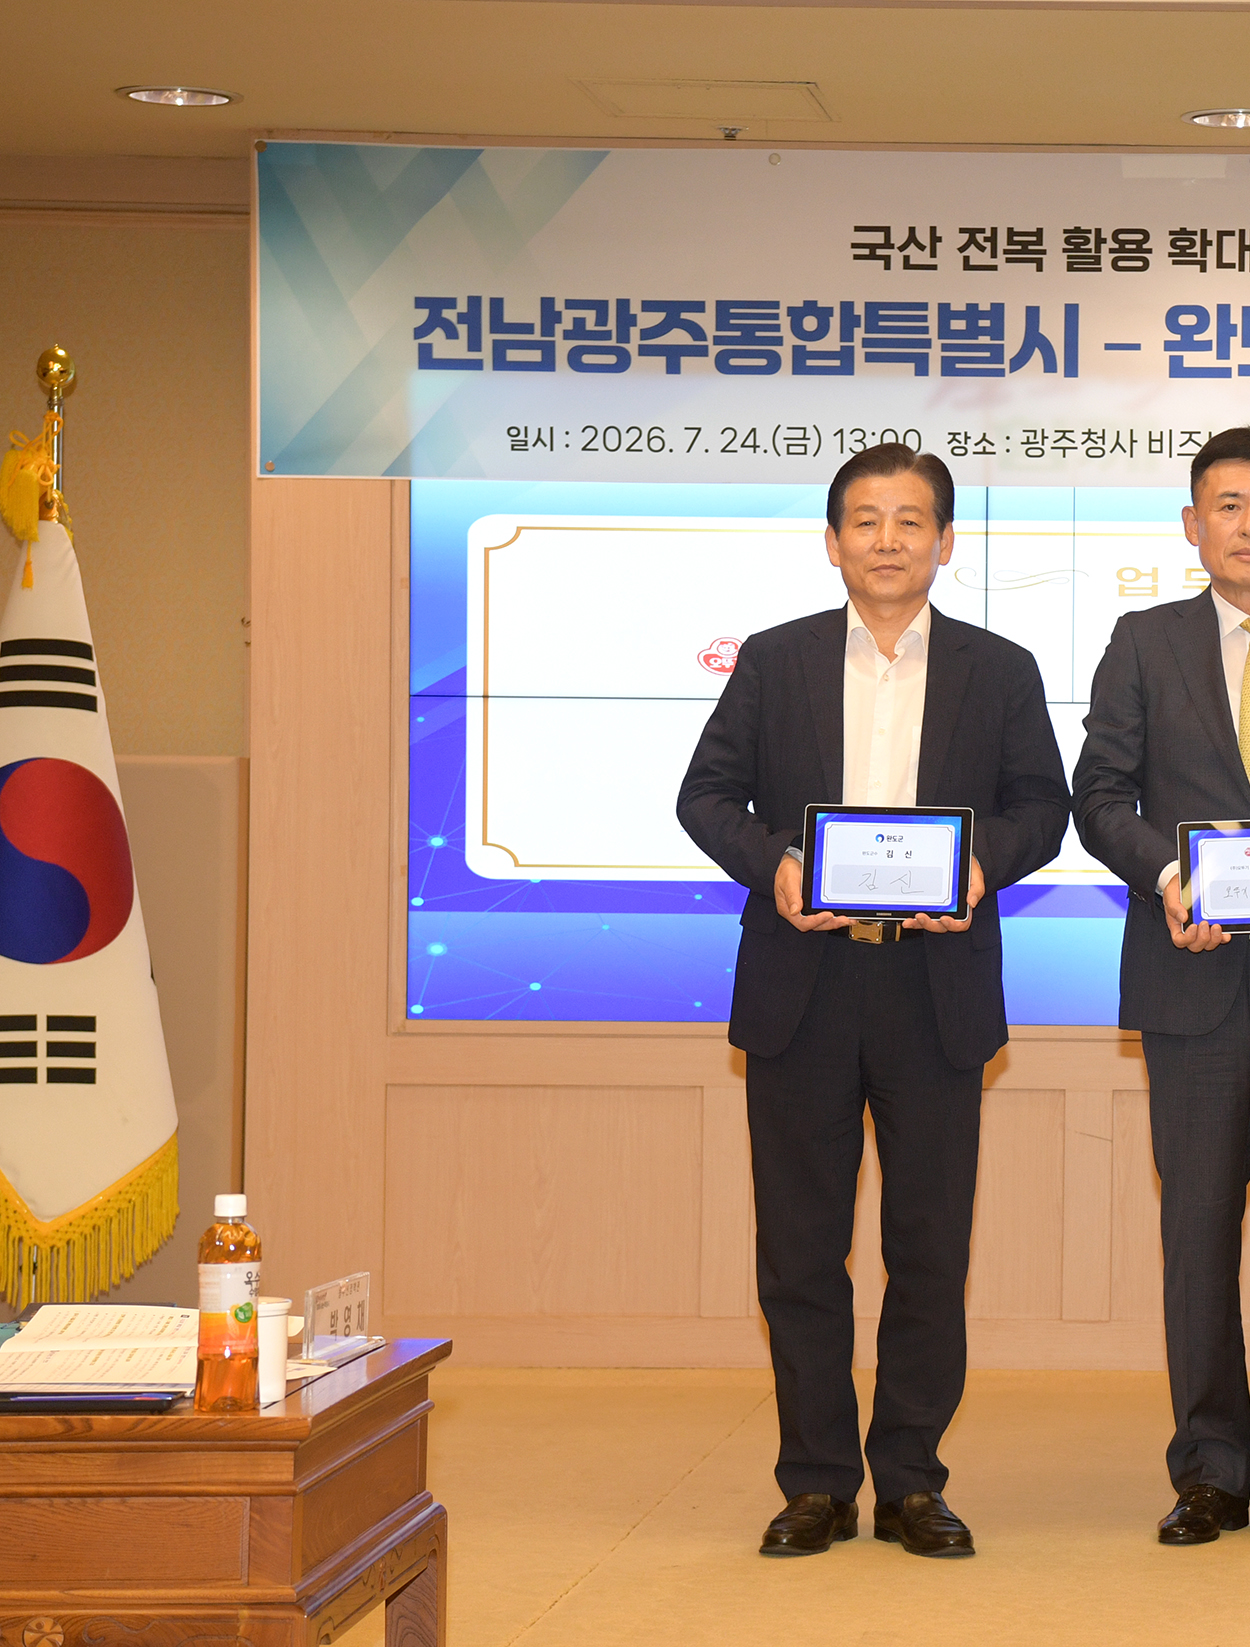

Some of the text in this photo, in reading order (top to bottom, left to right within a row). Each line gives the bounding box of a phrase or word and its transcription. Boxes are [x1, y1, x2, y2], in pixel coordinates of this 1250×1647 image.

[850, 225, 943, 271] 국산
[956, 226, 1047, 273] 전복
[1061, 226, 1153, 273] 활용
[413, 295, 1080, 379] 전남광주통합특별시
[506, 425, 555, 454] 일시
[581, 425, 674, 454] 2026.
[684, 427, 709, 455] 7.
[720, 425, 822, 459] 24.(금)
[946, 430, 997, 457] 장소
[1020, 428, 1138, 459] 광주청사
[708, 656, 738, 669] 오뚜
[886, 850, 893, 858] 김
[905, 850, 912, 858] 신
